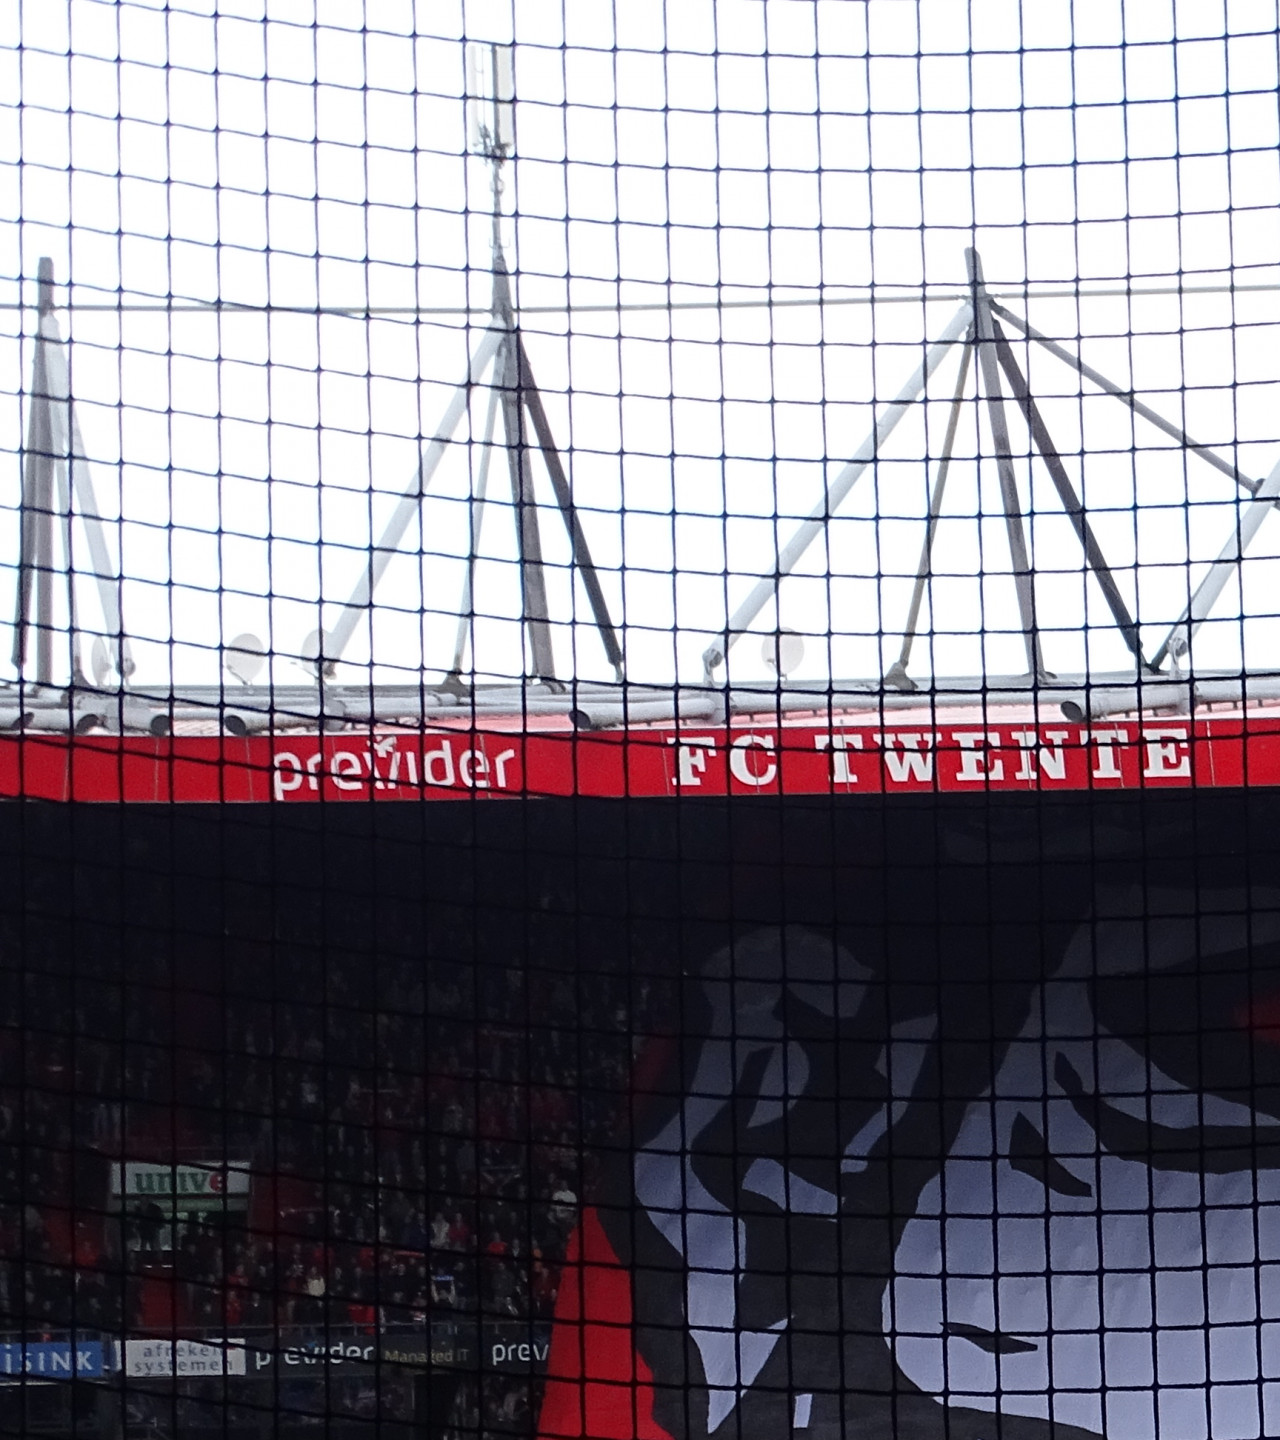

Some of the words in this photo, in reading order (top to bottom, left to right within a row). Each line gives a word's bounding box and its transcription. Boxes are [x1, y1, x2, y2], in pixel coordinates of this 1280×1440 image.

[667, 733, 777, 787] FC
[814, 728, 1191, 784] TWENTE
[255, 1342, 375, 1369] pevider
[385, 1350, 453, 1364] Manaed
